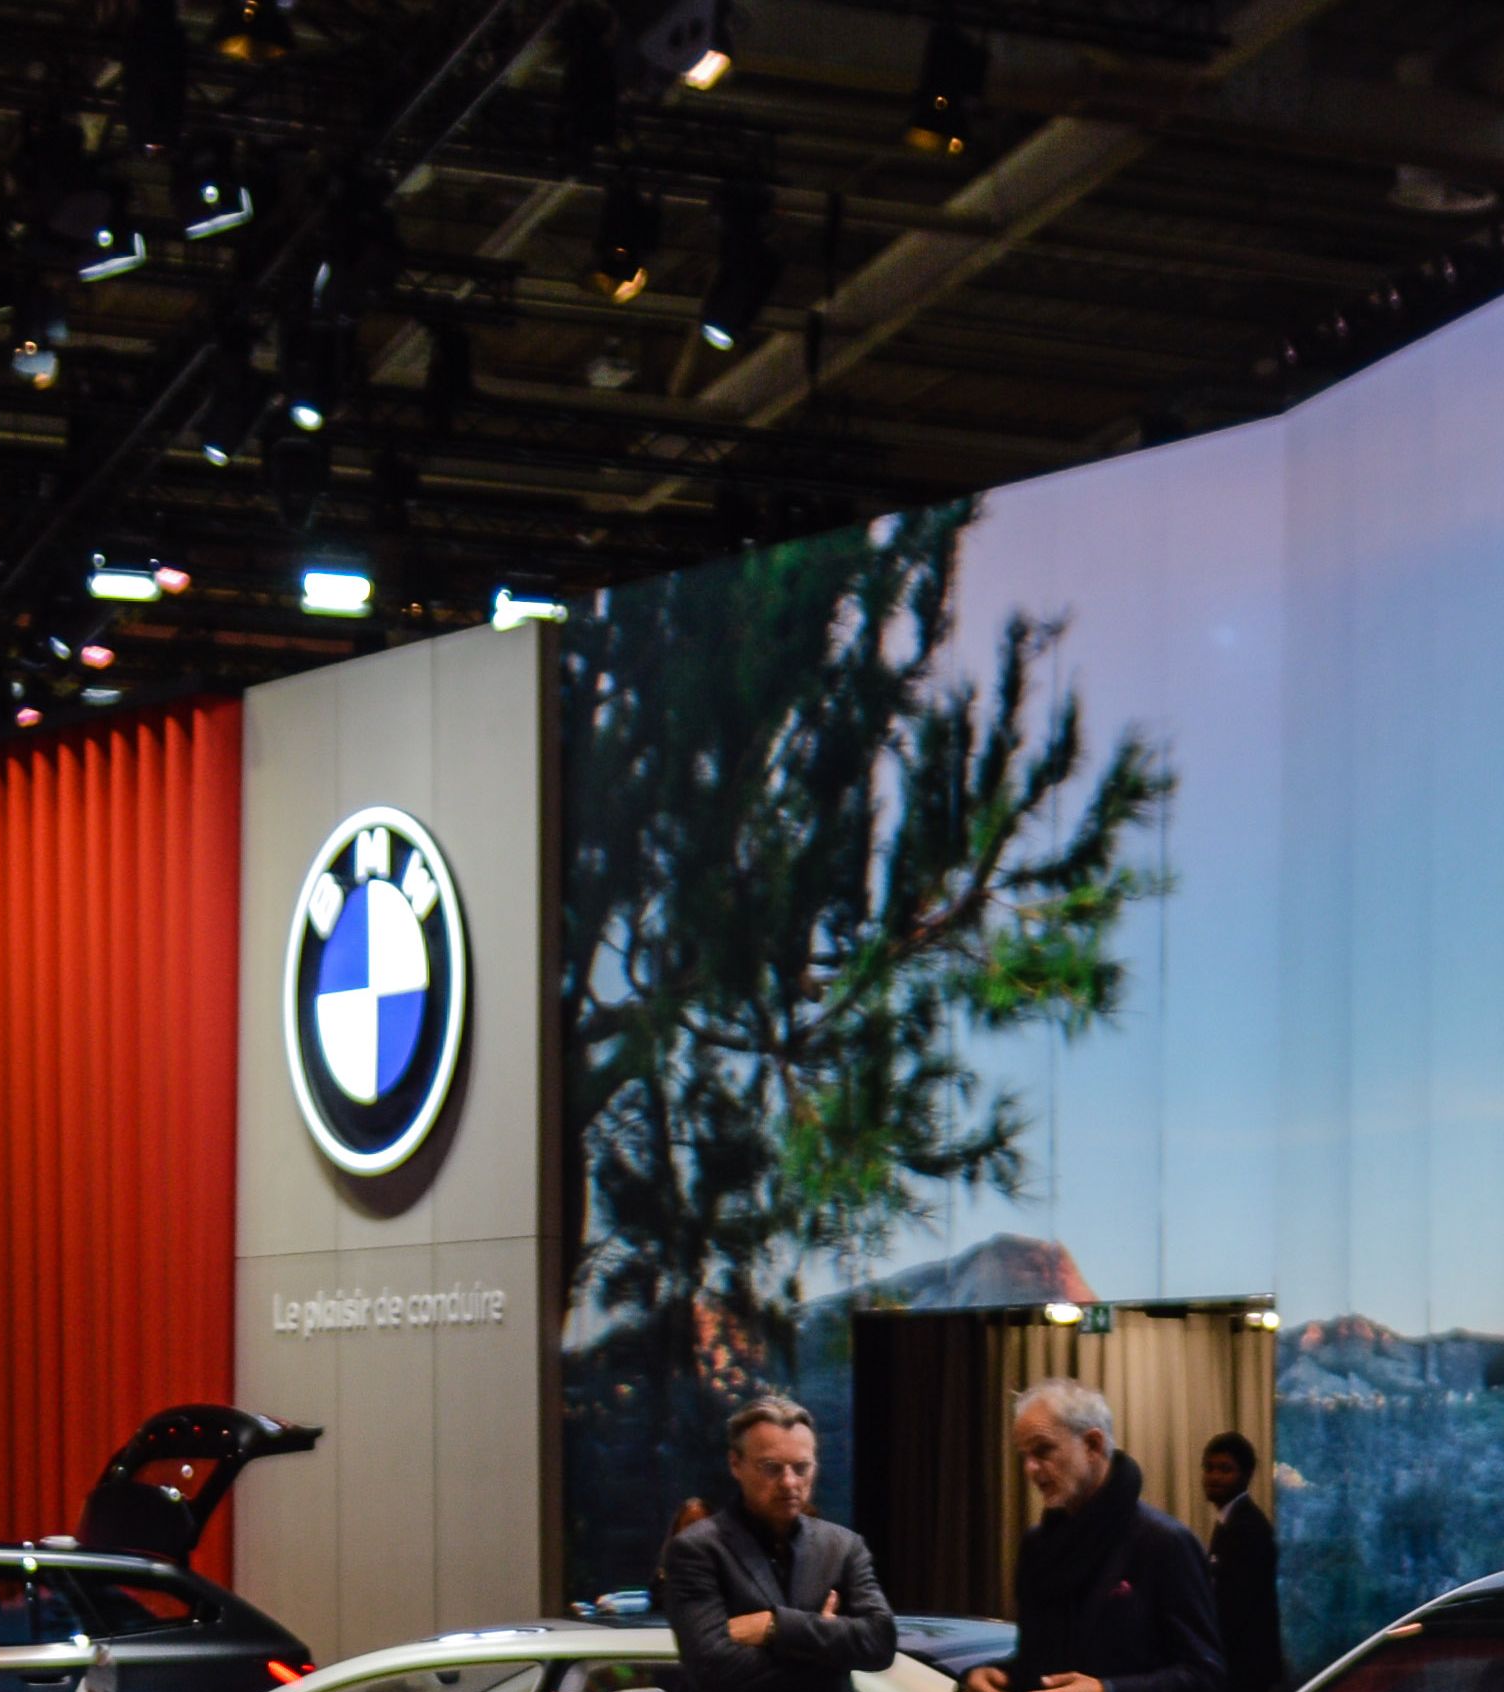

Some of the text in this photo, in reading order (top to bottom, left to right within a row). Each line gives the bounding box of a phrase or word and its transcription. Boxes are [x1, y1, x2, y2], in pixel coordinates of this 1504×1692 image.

[307, 826, 439, 941] BMW
[273, 1280, 506, 1341] Le plaisir de conduire
